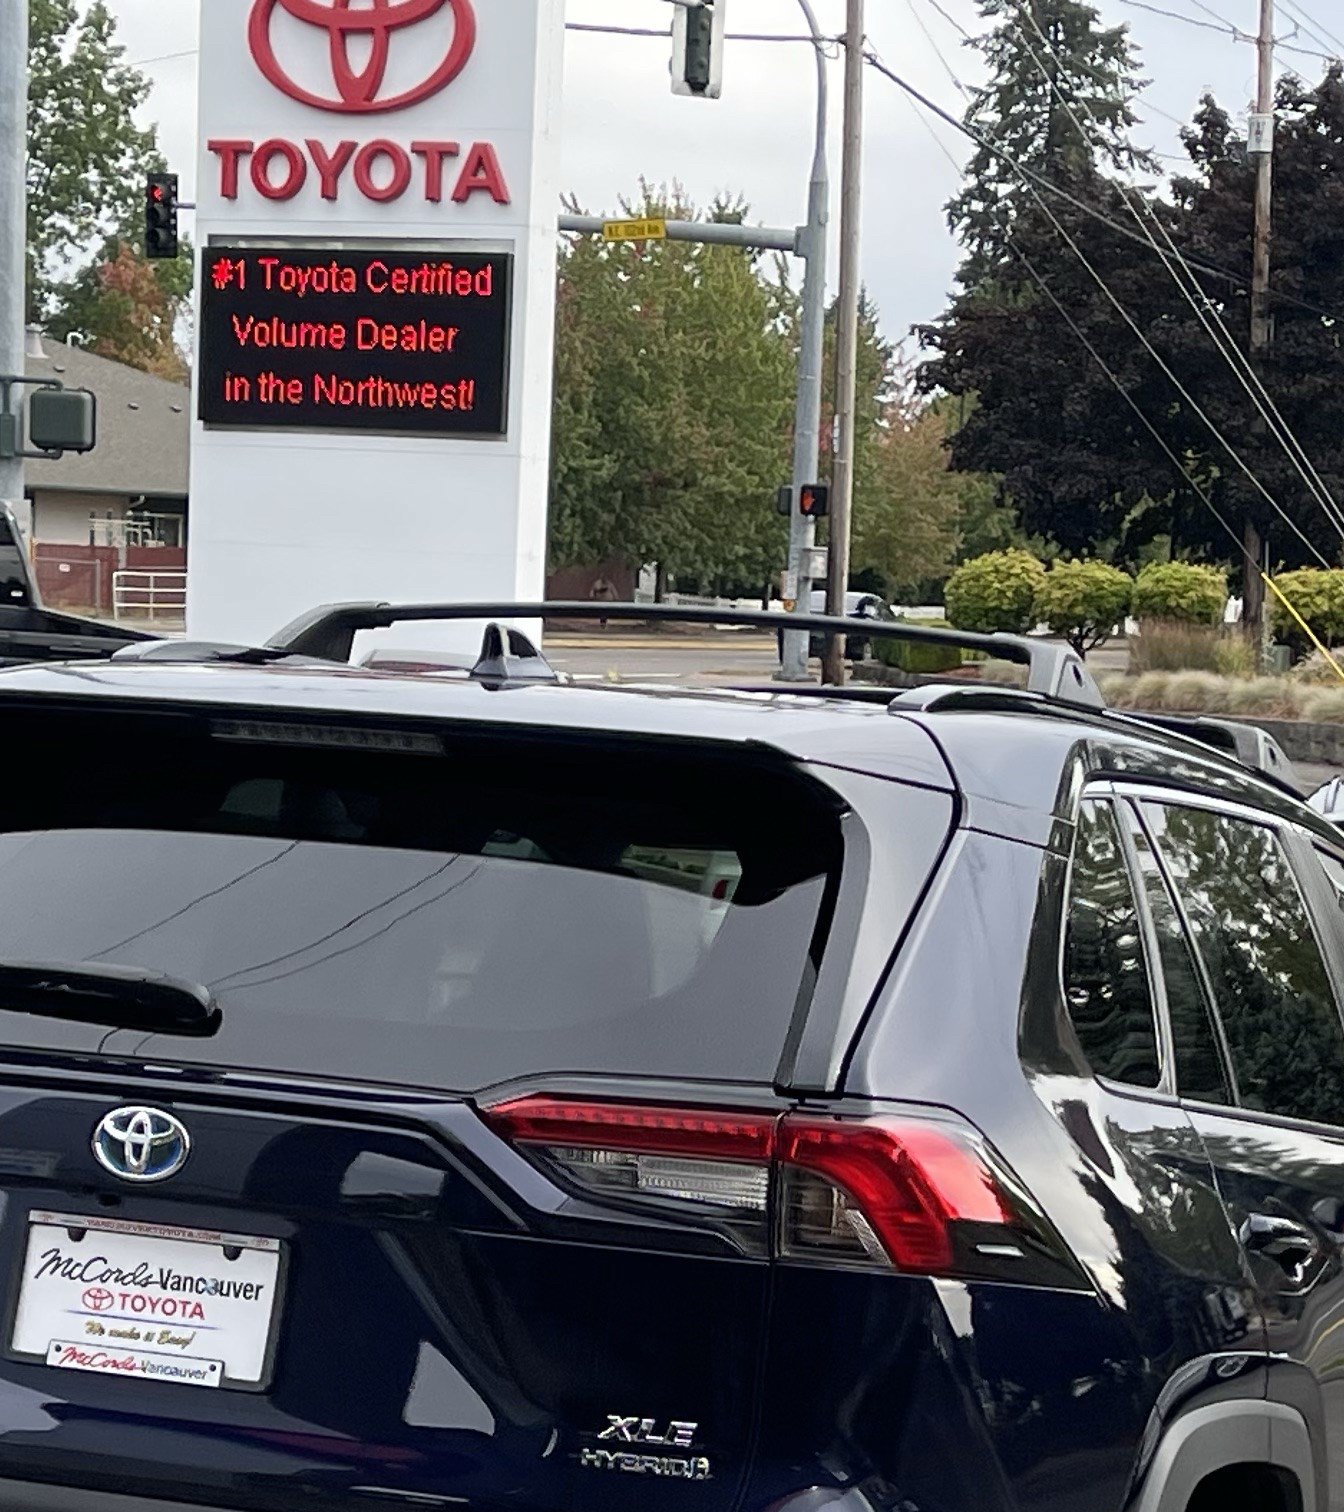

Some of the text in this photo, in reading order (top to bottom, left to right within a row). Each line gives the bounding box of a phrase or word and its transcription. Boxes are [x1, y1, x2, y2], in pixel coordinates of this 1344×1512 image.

[207, 138, 511, 205] TOYOTA
[211, 257, 493, 298] #1 Toyota Certified
[231, 312, 460, 353] Volume Dealer
[224, 370, 476, 411] in the Northwest!
[34, 1247, 265, 1301] McCords Vancouver
[118, 1291, 206, 1321] TOYOTA
[59, 1345, 209, 1381] McCords Vancouver
[597, 1414, 699, 1447] XLE
[580, 1447, 692, 1479] HYBRID
